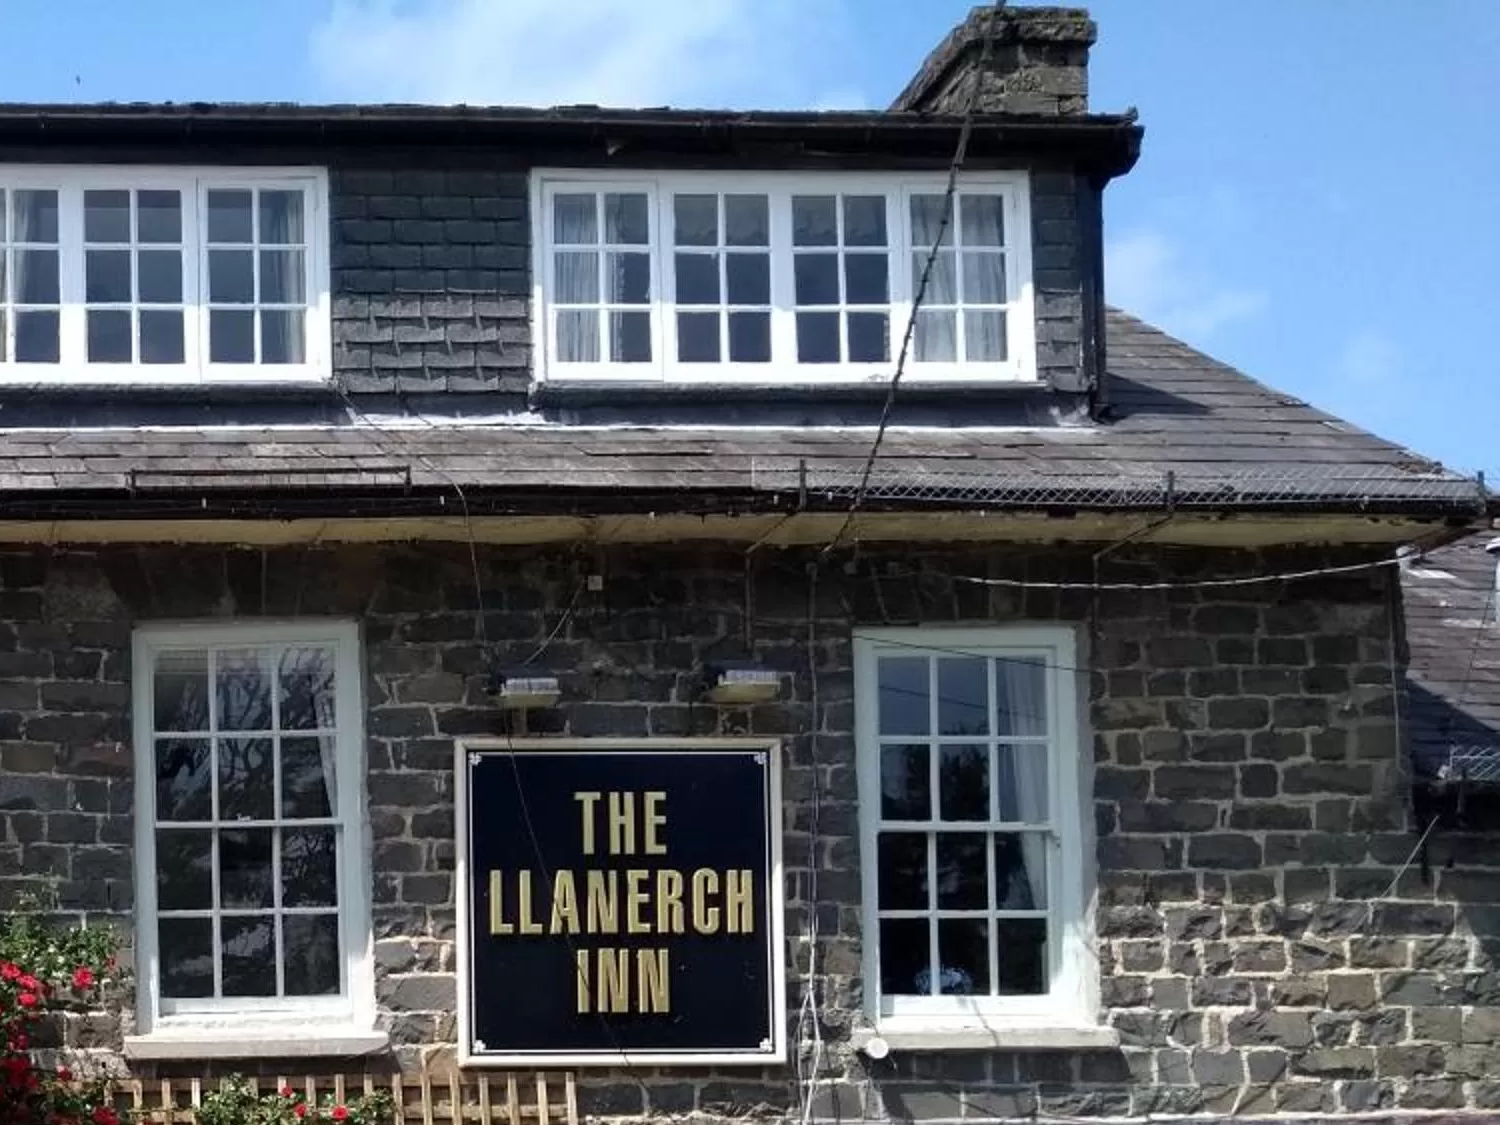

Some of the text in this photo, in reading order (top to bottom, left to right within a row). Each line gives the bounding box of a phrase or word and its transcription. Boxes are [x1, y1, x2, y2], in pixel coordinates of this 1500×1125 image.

[573, 791, 668, 855] THE
[488, 867, 754, 935] LLANERCH
[575, 947, 671, 1014] INN
